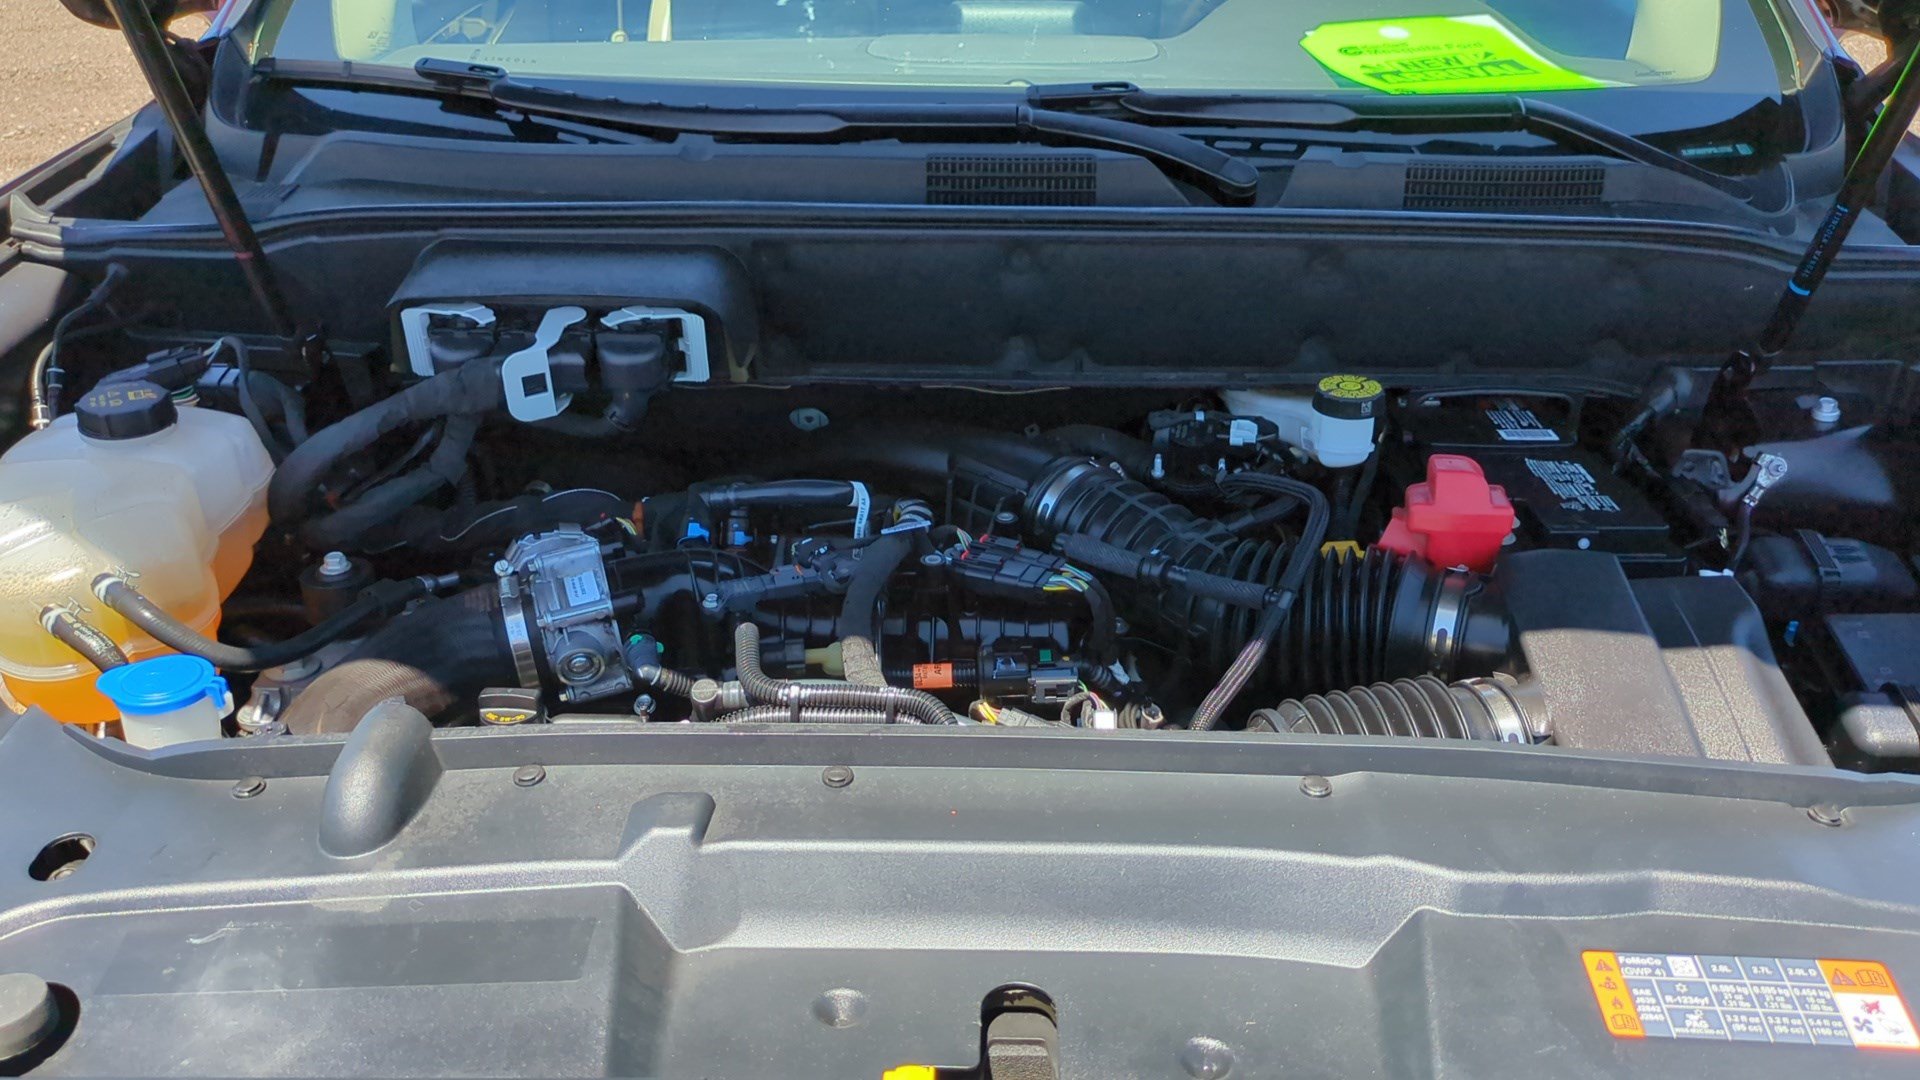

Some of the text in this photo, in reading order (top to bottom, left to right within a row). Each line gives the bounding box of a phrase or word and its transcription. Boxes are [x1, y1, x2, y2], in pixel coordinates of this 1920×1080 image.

[484, 56, 537, 64] LINCOLN
[1399, 55, 1464, 70] NEW
[1618, 956, 1661, 965] FoMoCo
[1622, 967, 1666, 977] (GWP 4)
[1752, 966, 1772, 975] 2.7L
[1632, 988, 1652, 996] SAE
[1665, 995, 1710, 1006] R-1234yf
[1685, 1020, 1709, 1028] PAG
[1767, 1016, 1781, 1024] 3.2
